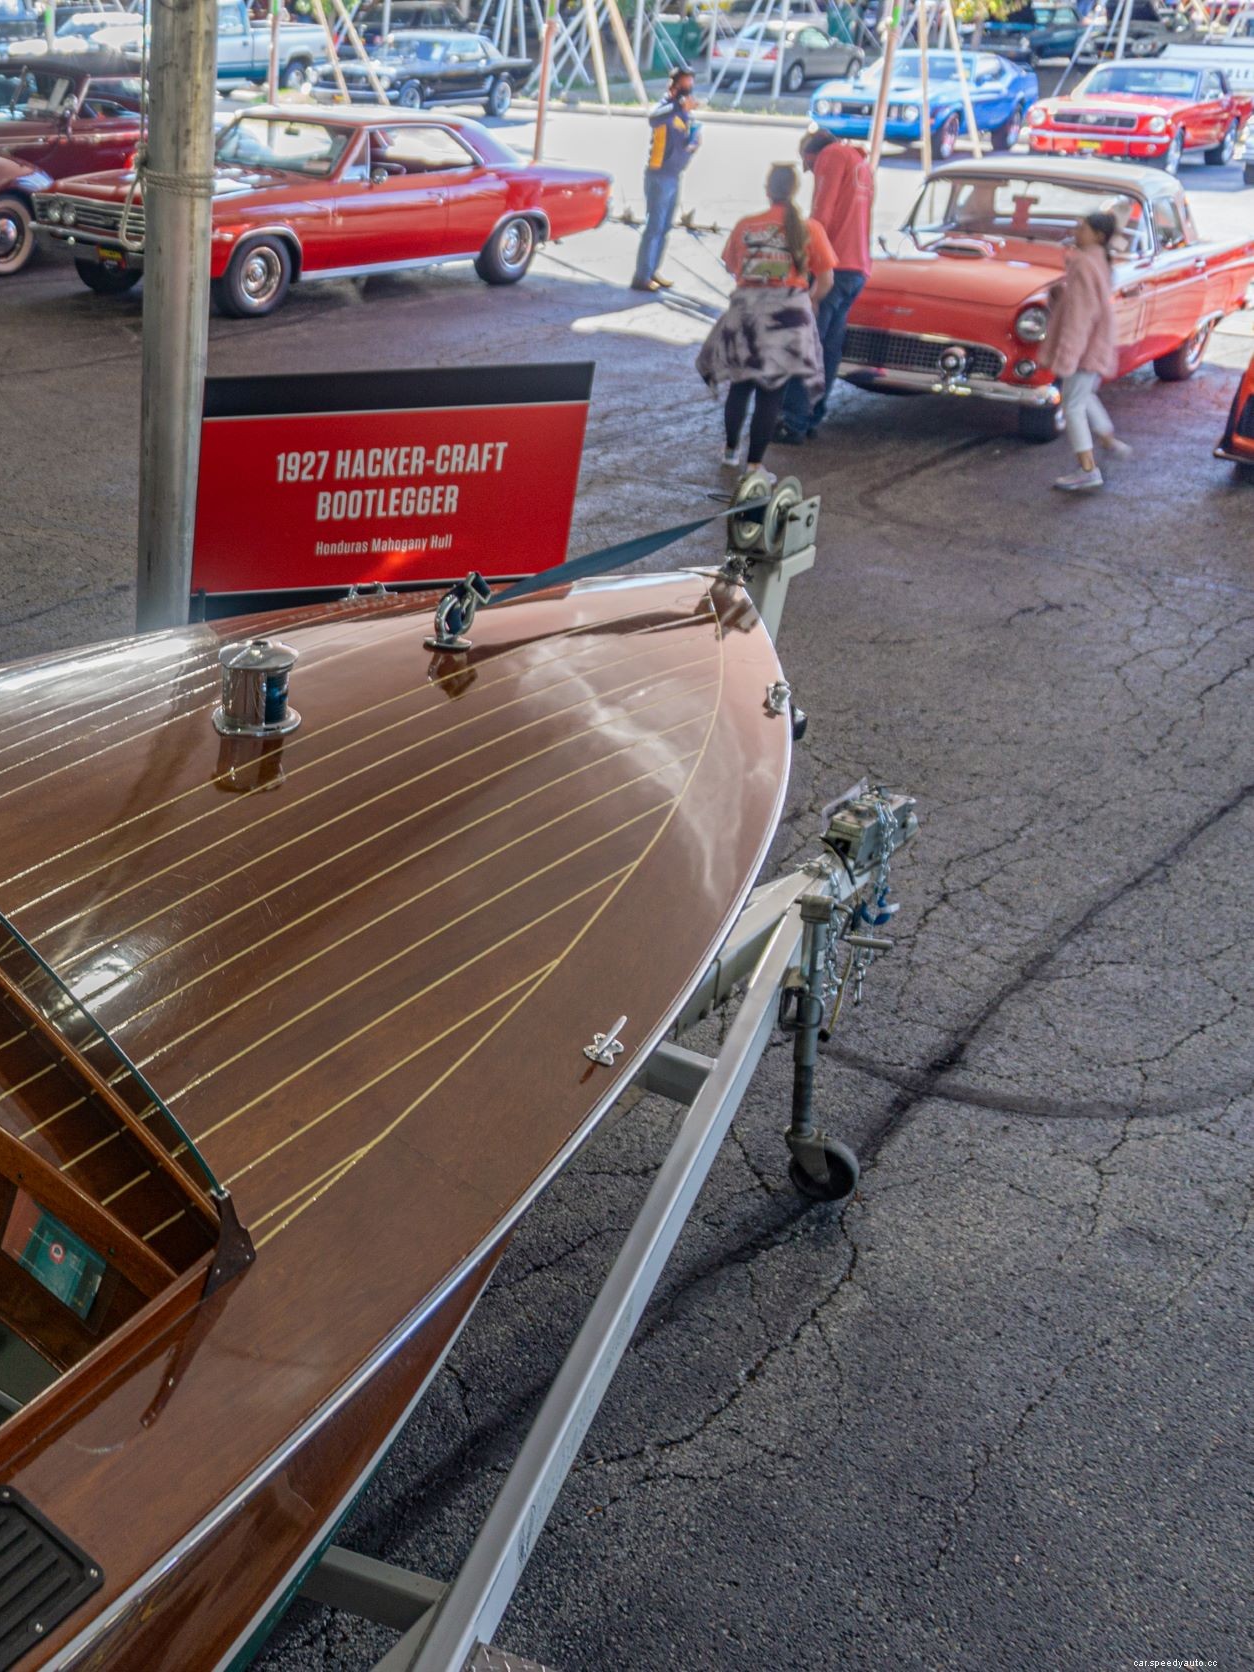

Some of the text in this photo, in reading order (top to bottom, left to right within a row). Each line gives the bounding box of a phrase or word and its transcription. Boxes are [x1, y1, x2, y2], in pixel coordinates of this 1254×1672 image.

[277, 442, 508, 482] 1927 HACKER-CRAFT
[316, 485, 460, 521] BOOTLEGGER
[314, 534, 453, 556] Honduras Mahogany Hull
